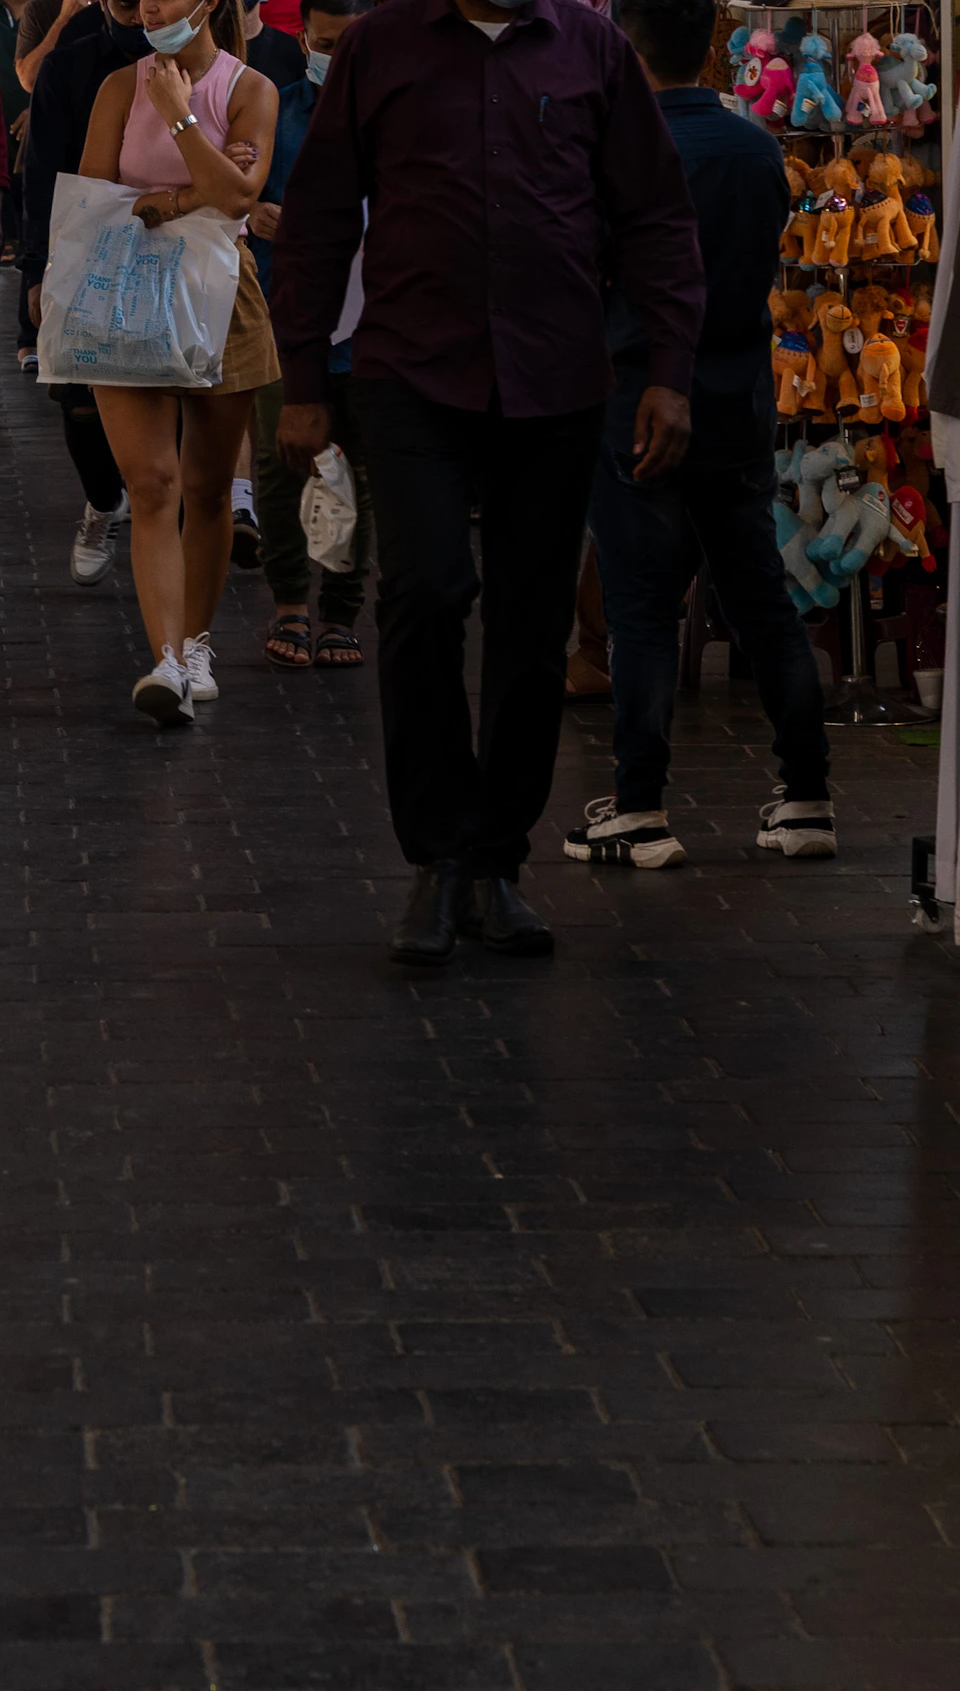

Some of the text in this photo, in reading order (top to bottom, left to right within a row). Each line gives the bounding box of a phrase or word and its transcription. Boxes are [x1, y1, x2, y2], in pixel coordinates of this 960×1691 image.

[136, 258, 158, 266] YOU
[87, 280, 110, 291] YOU
[75, 355, 97, 365] YOU
